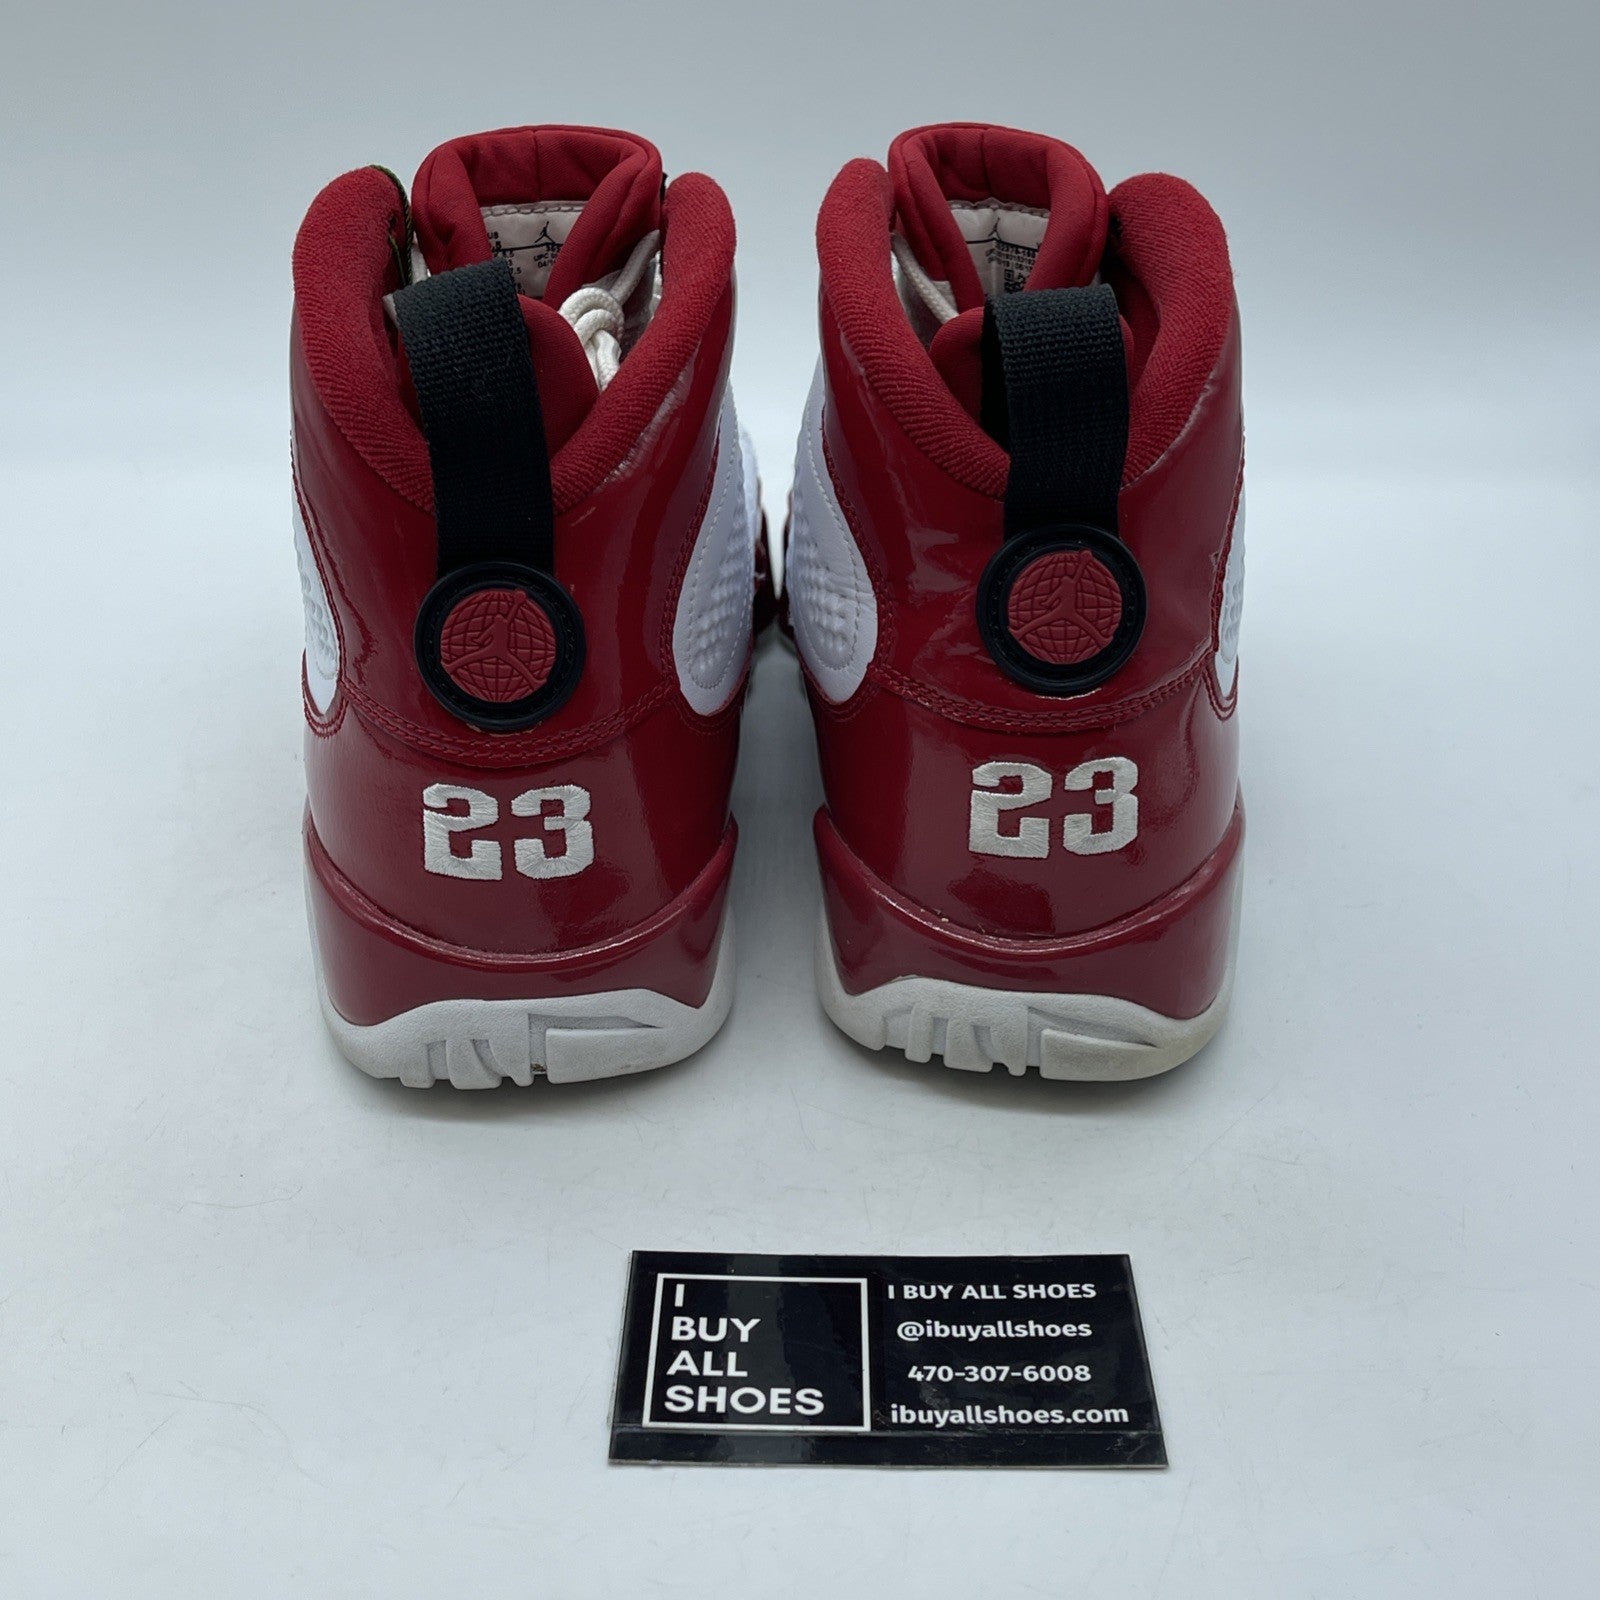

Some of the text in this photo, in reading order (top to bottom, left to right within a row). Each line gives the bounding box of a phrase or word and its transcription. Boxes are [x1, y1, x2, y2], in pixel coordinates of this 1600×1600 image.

[968, 756, 1139, 859] 23
[422, 783, 594, 881] 23
[674, 1283, 685, 1307] I
[888, 1283, 1097, 1300] I BUY ALL SHOES
[671, 1316, 761, 1343] BUY
[896, 1319, 1093, 1342] @ibuyallshoes
[666, 1350, 748, 1378] ALL
[907, 1365, 1092, 1382] 470-307-6008
[664, 1385, 825, 1416] SHOES
[891, 1403, 1129, 1428] ibuyallshoes.com
